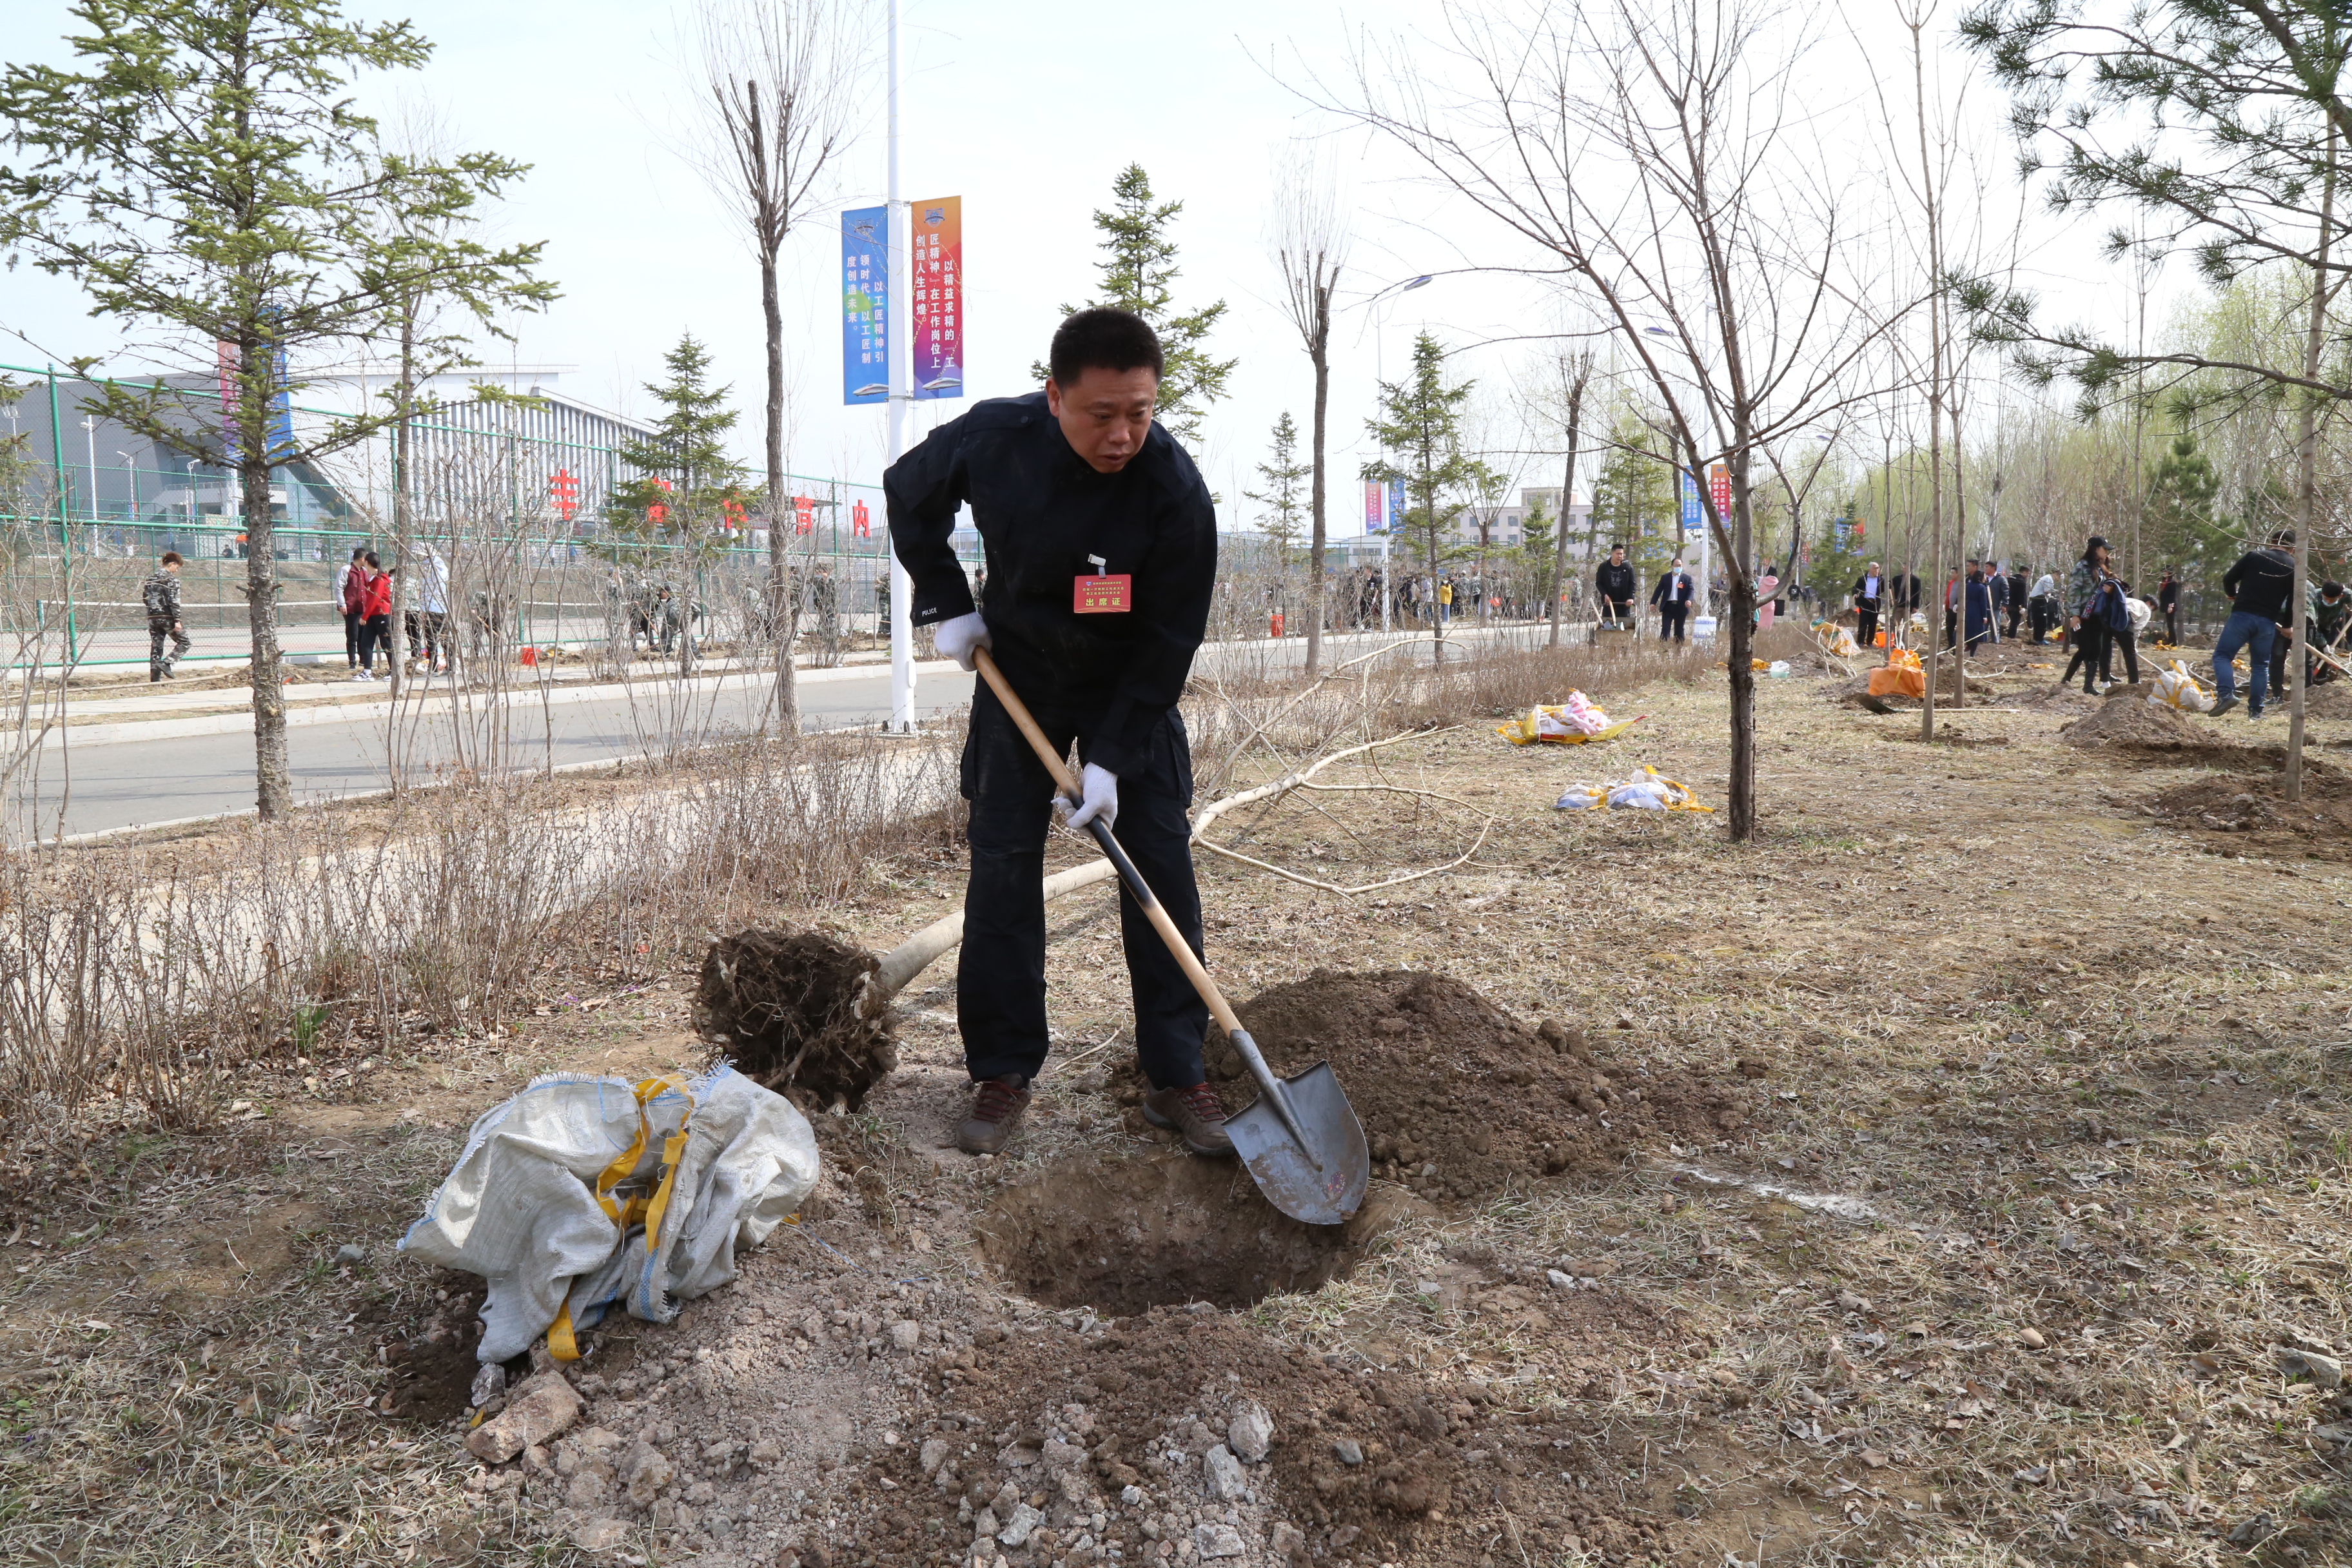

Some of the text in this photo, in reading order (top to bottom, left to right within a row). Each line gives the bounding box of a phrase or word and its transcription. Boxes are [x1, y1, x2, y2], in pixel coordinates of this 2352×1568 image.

[874, 281, 884, 362] 以工匠精神引
[1086, 598, 1121, 606] 出席证
[922, 607, 937, 616] POLICE
